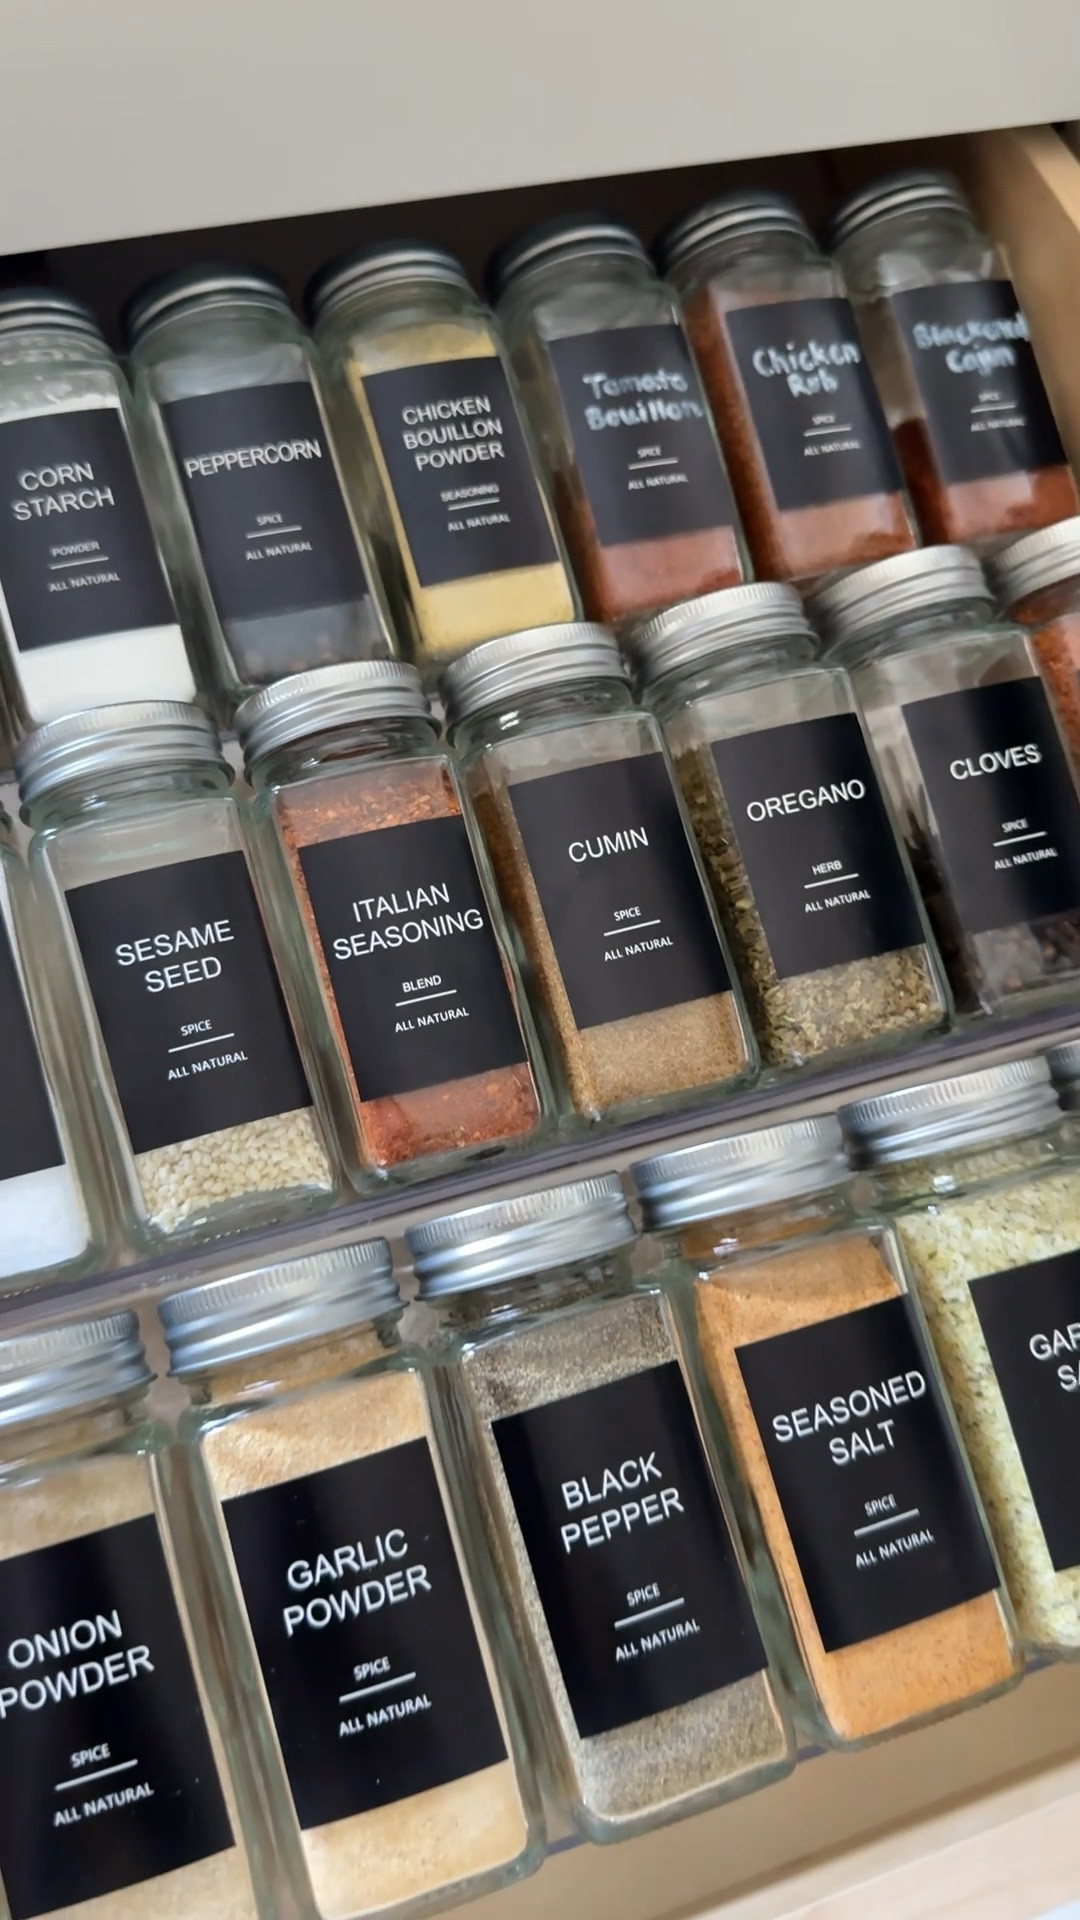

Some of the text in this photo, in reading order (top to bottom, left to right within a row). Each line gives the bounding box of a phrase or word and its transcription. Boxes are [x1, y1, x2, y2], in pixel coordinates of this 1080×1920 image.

[404, 398, 489, 424] CHICKEN
[971, 417, 1025, 432] ALL NATURAL
[404, 420, 503, 449] BOUILLON
[804, 439, 860, 457] ALL NATURAL
[186, 439, 322, 478] PEPPERCORN
[416, 443, 504, 470] POWDER
[638, 447, 662, 459] SPICE
[20, 463, 93, 491] CORN
[628, 473, 689, 491] ALL NATURAL
[14, 488, 114, 520] STARCH
[441, 484, 499, 501] SEASONING
[257, 513, 284, 526] SPICE
[448, 513, 510, 532] ALL NATURAL
[51, 541, 101, 557] POWDER
[246, 542, 313, 561] ALL NATURAL
[49, 571, 121, 593] ALL NATURAL
[950, 743, 1042, 780] CLOVES
[746, 779, 866, 822] OREGANO
[1001, 818, 1029, 833] SPICE
[568, 827, 649, 863] CUMIN
[993, 846, 1059, 870] ALL NATURAL
[811, 859, 843, 876] HERB
[352, 883, 449, 921] ITALIAN
[613, 905, 642, 922] SPICE
[803, 889, 872, 913] ALL NATURAL
[115, 920, 234, 965] SESAME
[333, 908, 484, 959] SEASONING
[603, 935, 674, 962] ALL NATURAL
[145, 956, 222, 992] SEED
[401, 973, 443, 994] BLEND
[180, 1018, 213, 1037] SPICE
[393, 1005, 470, 1034] ALL NATURAL
[167, 1049, 249, 1081] ALL NATURAL
[772, 1371, 927, 1443] SEASONED
[828, 1419, 898, 1467] SALT
[561, 1451, 662, 1510] BLACK
[864, 1493, 897, 1516] SPICE
[560, 1487, 684, 1554] PEPPER
[286, 1528, 409, 1592] GARLIC
[854, 1526, 936, 1570] ALL NATURAL
[283, 1564, 432, 1636] POWDER
[626, 1582, 661, 1607] SPICE
[8, 1609, 123, 1670] ONION
[614, 1617, 701, 1663] ALL NATURAL
[0, 1645, 155, 1720] POWDER
[353, 1656, 391, 1683] SPICE
[338, 1695, 432, 1738] ALL NATURAL
[70, 1743, 111, 1769] SPICE
[53, 1780, 155, 1828] ALL NATURAL
